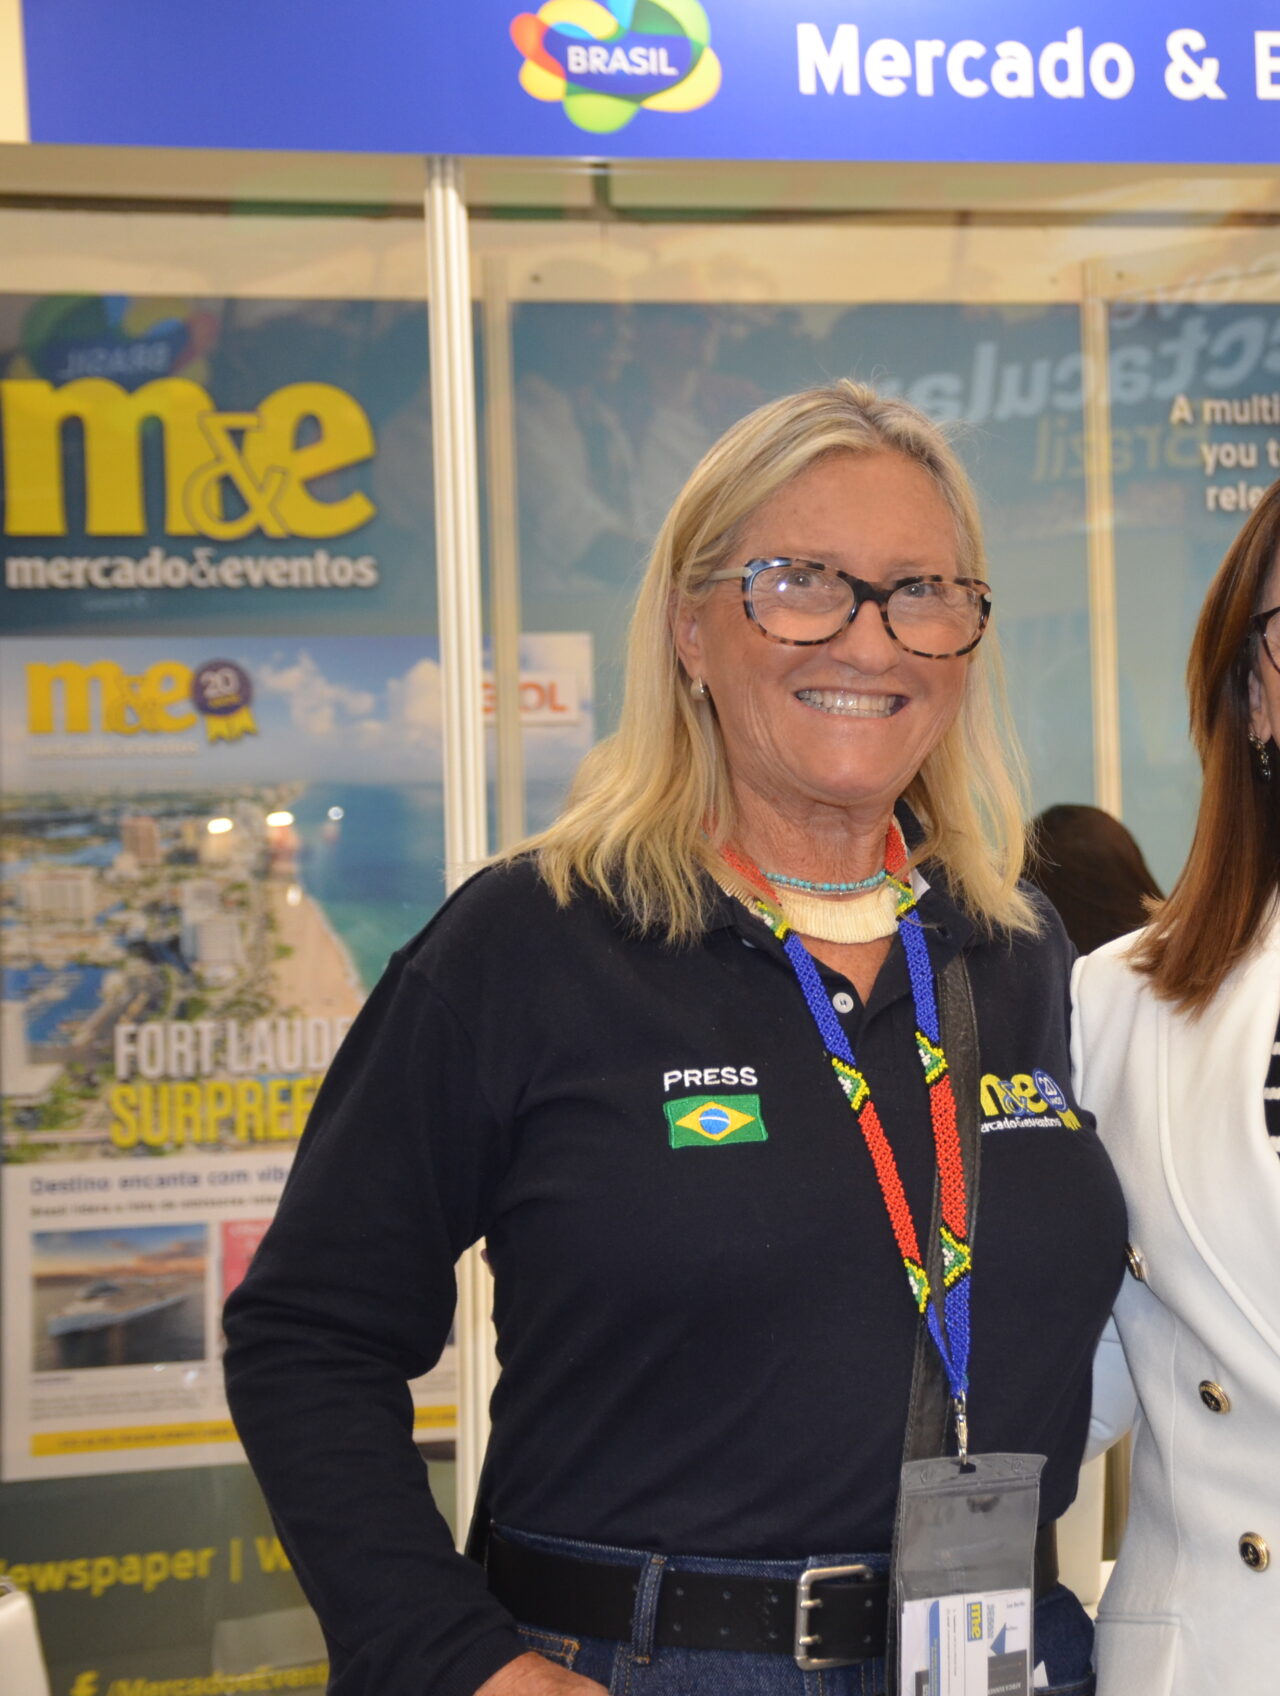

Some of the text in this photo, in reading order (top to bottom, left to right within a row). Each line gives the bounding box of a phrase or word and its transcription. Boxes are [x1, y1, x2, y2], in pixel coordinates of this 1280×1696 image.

[567, 45, 679, 76] BRASIL
[797, 23, 1135, 100] Mercado
[1164, 28, 1227, 101] &
[1168, 393, 1195, 425] A
[0, 377, 376, 541] m&e
[1200, 442, 1258, 477] you
[5, 546, 380, 589] mercado&eventos
[26, 660, 199, 734] m&e
[114, 1020, 216, 1079] FORT
[664, 1067, 758, 1092] PRESS
[109, 1074, 324, 1148] SURPREE
[31, 1175, 109, 1195] Destino
[118, 1171, 200, 1191] encanta
[207, 1167, 248, 1187] com
[0, 1545, 217, 1598] ewspaper
